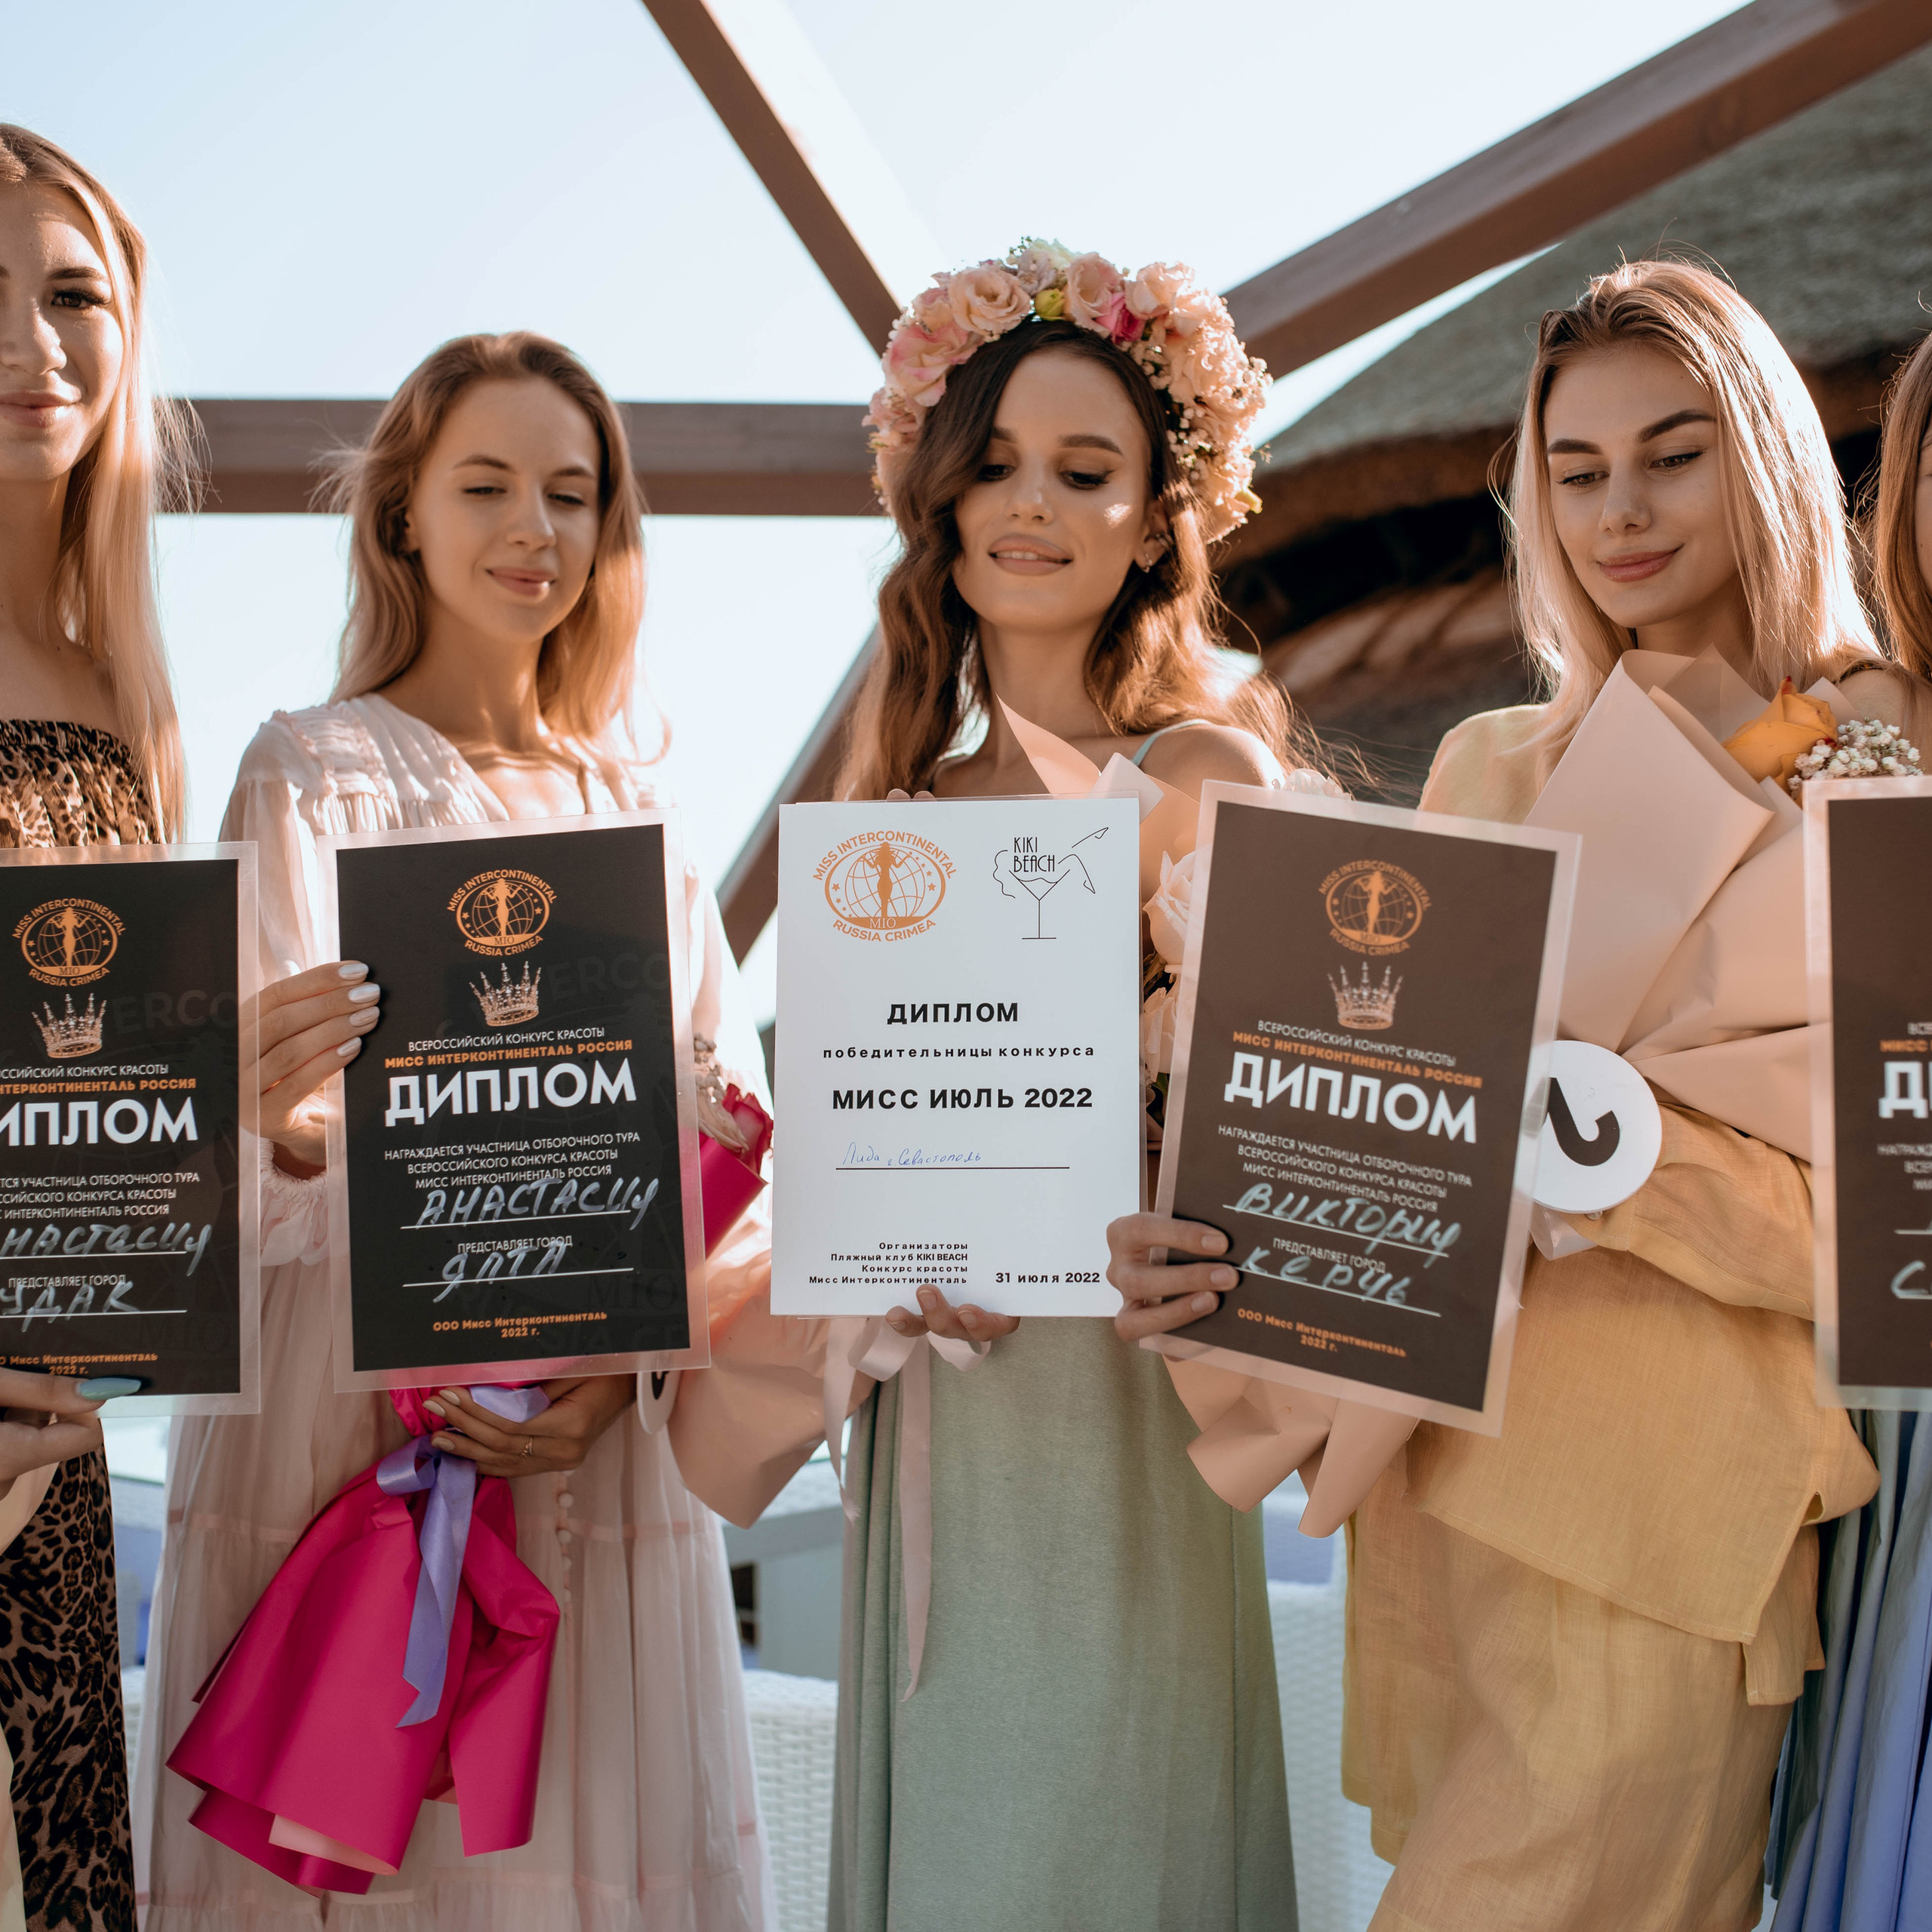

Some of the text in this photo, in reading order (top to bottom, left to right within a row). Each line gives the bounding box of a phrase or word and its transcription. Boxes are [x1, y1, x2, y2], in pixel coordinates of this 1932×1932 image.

[812, 830, 957, 881] MISS INTERCONTINENTAL
[1014, 837, 1038, 853] KIKI
[1014, 855, 1054, 872] BEACH
[447, 869, 557, 911] MISS INTERCONTINENTAL
[1318, 860, 1432, 911] MISS INTERCONTINENTAL
[12, 898, 126, 939] MISS INTERCONTINENTAL
[869, 918, 896, 928] MIO
[833, 919, 936, 942] RUSSIA CRIMEA
[464, 935, 543, 956] RUSSIA CRIMEA
[494, 937, 515, 946] MIO
[1329, 928, 1411, 956] RUSSIA CRIMEA
[29, 967, 110, 986] RUSSIA CRIMEA
[59, 967, 80, 976] MIO
[888, 1003, 1017, 1024] ДИПЛОМ
[408, 1028, 604, 1051] ВСЕРОССИЙСКИЙ КОНКУРС КРАСОТЫ
[1258, 1020, 1456, 1066] ВСЕРОССИЙСКИЙ КОНКУРС КРАСОТЫ
[385, 1040, 632, 1068] МИСС ИНТЕРКОНТИНЕНТАЛЬ РОССИЯ
[824, 1047, 1093, 1058] победительницы конкурса
[1233, 1032, 1482, 1088] МИСС ИНТЕРКОНТИНЕНТАЛЬ РОССИЯ
[0, 1064, 168, 1078] ССИЙСКИЙ КОНКУРС КРАСОТЫ
[140, 1078, 195, 1090] РОССИЯ
[385, 1058, 636, 1127] ДИПЛОМ
[833, 1088, 1092, 1109] МИСС ИЮЛЬ 2022
[1224, 1052, 1476, 1143] ДИПЛОМ
[385, 1132, 640, 1160] НАГРАЖДАЕТСЯ УЧАСТНИЦА ОТБОРОЧНОГО ТУРА
[1219, 1124, 1472, 1186] НАГРАЖДАЕТСЯ УЧАСТНИЦА ОТБОРОЧНОГО ТУРА
[408, 1149, 617, 1174] ВСЕРОССИЙСКОГО КОНКУРСА КРАСОТЫ
[1238, 1144, 1447, 1198] ВСЕРОССИЙСКОГО КОНКУРСА КРАСОТЫ
[21, 1177, 87, 1187] УЧАСТНИЦА
[90, 1173, 172, 1185] ОТБОРОЧНОГО
[174, 1172, 200, 1183] ТУРА
[416, 1164, 611, 1189] МИСС ИНТЕРКОНТИНЕНТАЛЬ РОССИЯ
[1243, 1162, 1438, 1212] МИСС ИНТЕРКОНТИНЕНТАЛЬ РОССИЯ
[67, 1191, 125, 1201] КОНКУРСА
[128, 1189, 176, 1199] КРАСОТЫ
[5, 1206, 122, 1219] ИНТЕРКОНТИНЕНТАЛЬ
[125, 1204, 169, 1215] РОССИЯ
[457, 1238, 536, 1254] ПРЕДСТАВЛЯЕТ
[1272, 1238, 1386, 1273] ПРЕДСТАВЛЯЕТ ГОРОД
[8, 1274, 126, 1288] ПРЕДСТАВЛЯЕТ ГОРОД
[842, 1276, 967, 1284] Интерконтиненталь
[996, 1272, 1010, 1283] 31
[1066, 1272, 1100, 1282] 2022
[433, 1312, 607, 1331] ООО Мисс Интерконтиненталь
[501, 1326, 528, 1338] 2022
[1238, 1309, 1406, 1357] ООО Мисс Интерконтиненталь
[1300, 1334, 1337, 1352] 2022 г.
[11, 1355, 39, 1364] Мисс
[43, 1353, 158, 1365] Интерконтиненталь
